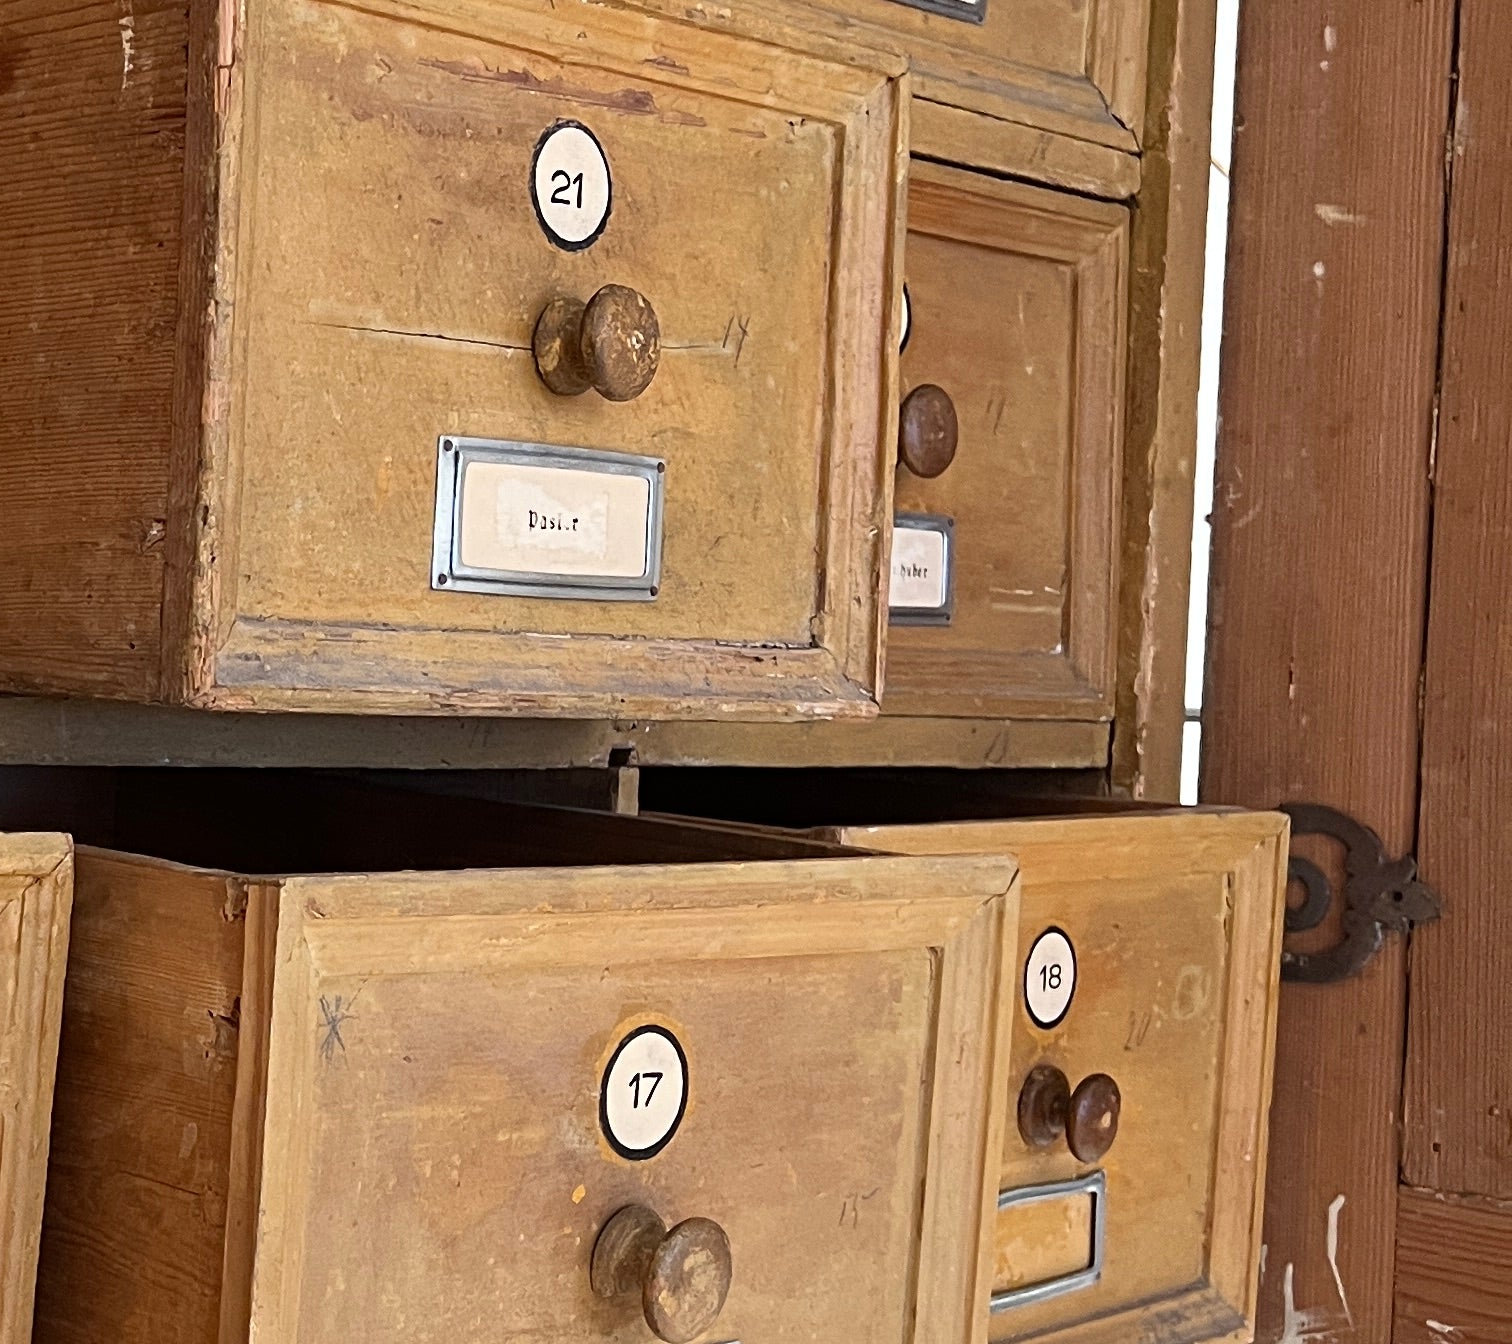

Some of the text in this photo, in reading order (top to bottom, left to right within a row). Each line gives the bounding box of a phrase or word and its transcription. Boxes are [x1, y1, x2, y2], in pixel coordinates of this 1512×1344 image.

[551, 169, 583, 208] 21
[1039, 963, 1062, 993] 18
[628, 1071, 664, 1109] 17
